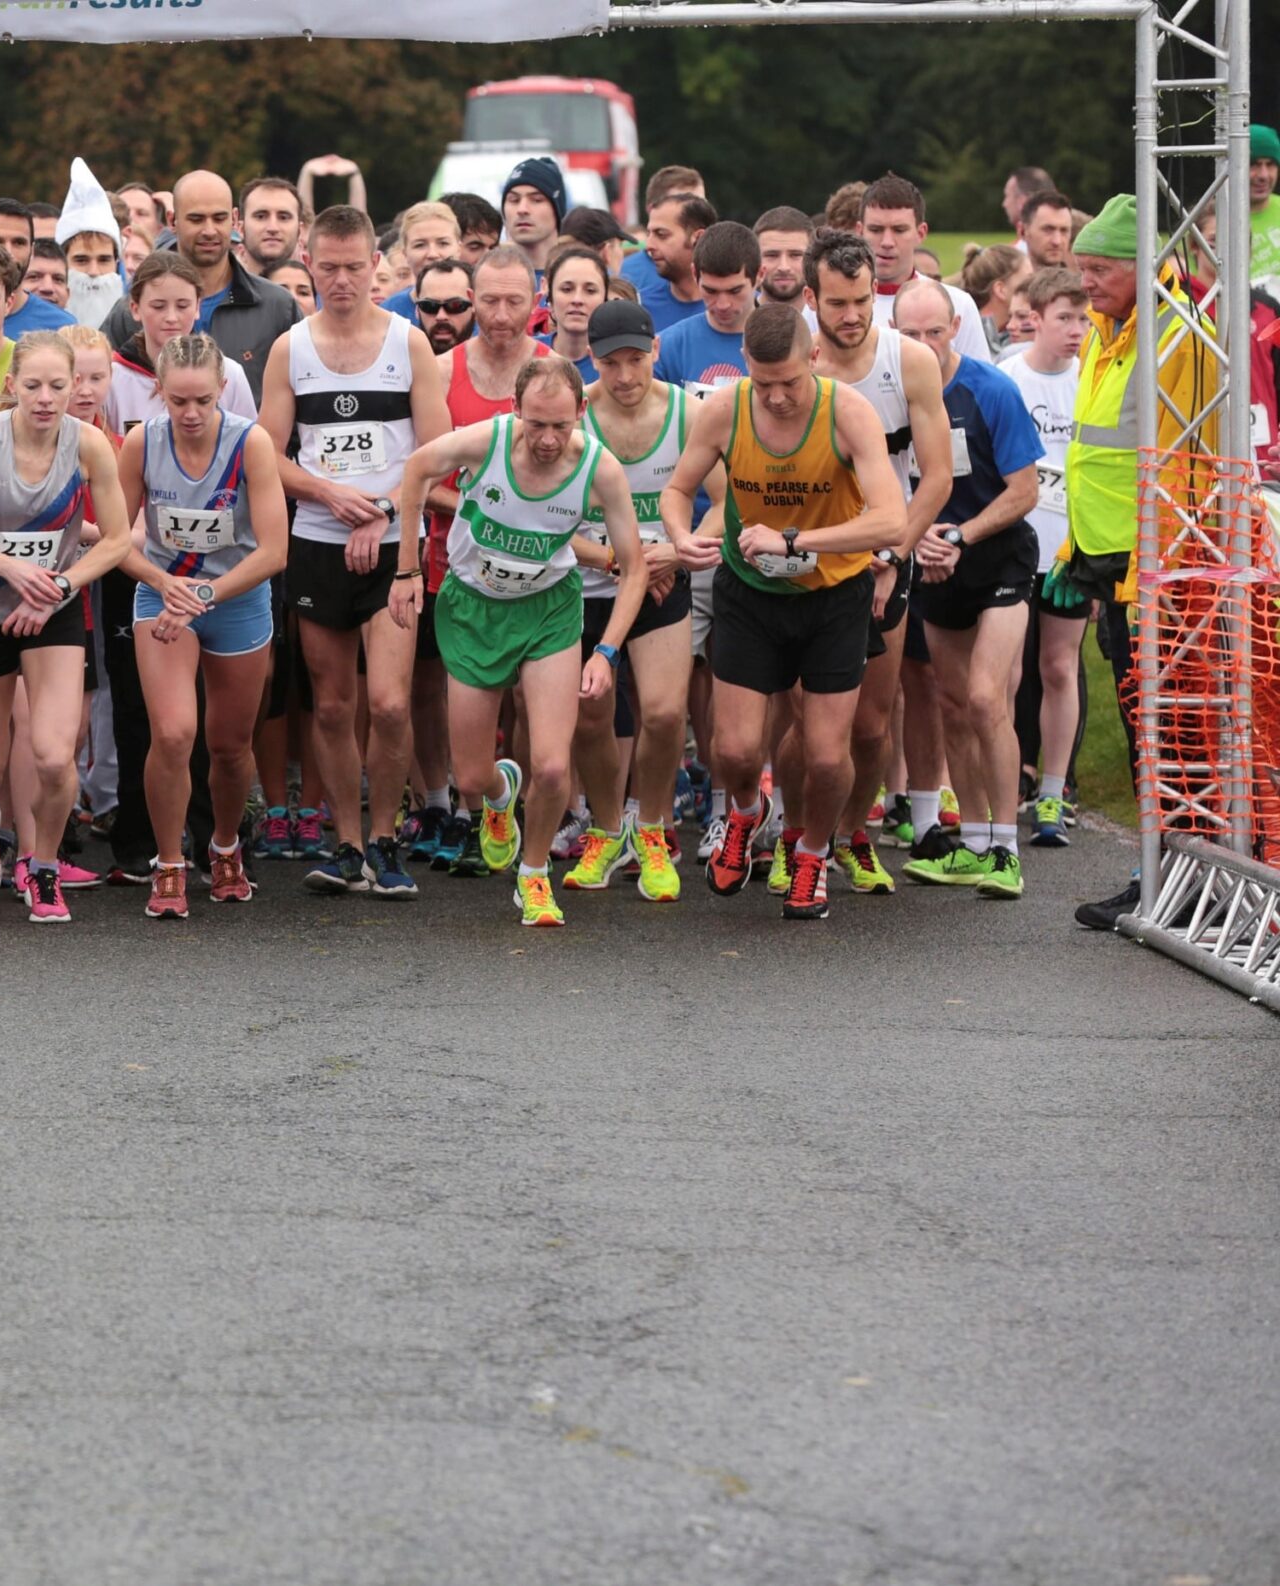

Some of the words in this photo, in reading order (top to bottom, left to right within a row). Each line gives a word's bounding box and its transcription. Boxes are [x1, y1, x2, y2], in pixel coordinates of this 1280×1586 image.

[323, 432, 373, 454] 328
[733, 478, 764, 494] BROS.
[766, 481, 809, 494] PEARSE
[763, 495, 805, 507] DUBLIN
[546, 504, 578, 517] LEYDENS
[169, 515, 222, 533] 172
[1, 539, 54, 557] 239
[480, 521, 558, 557] RAHENY
